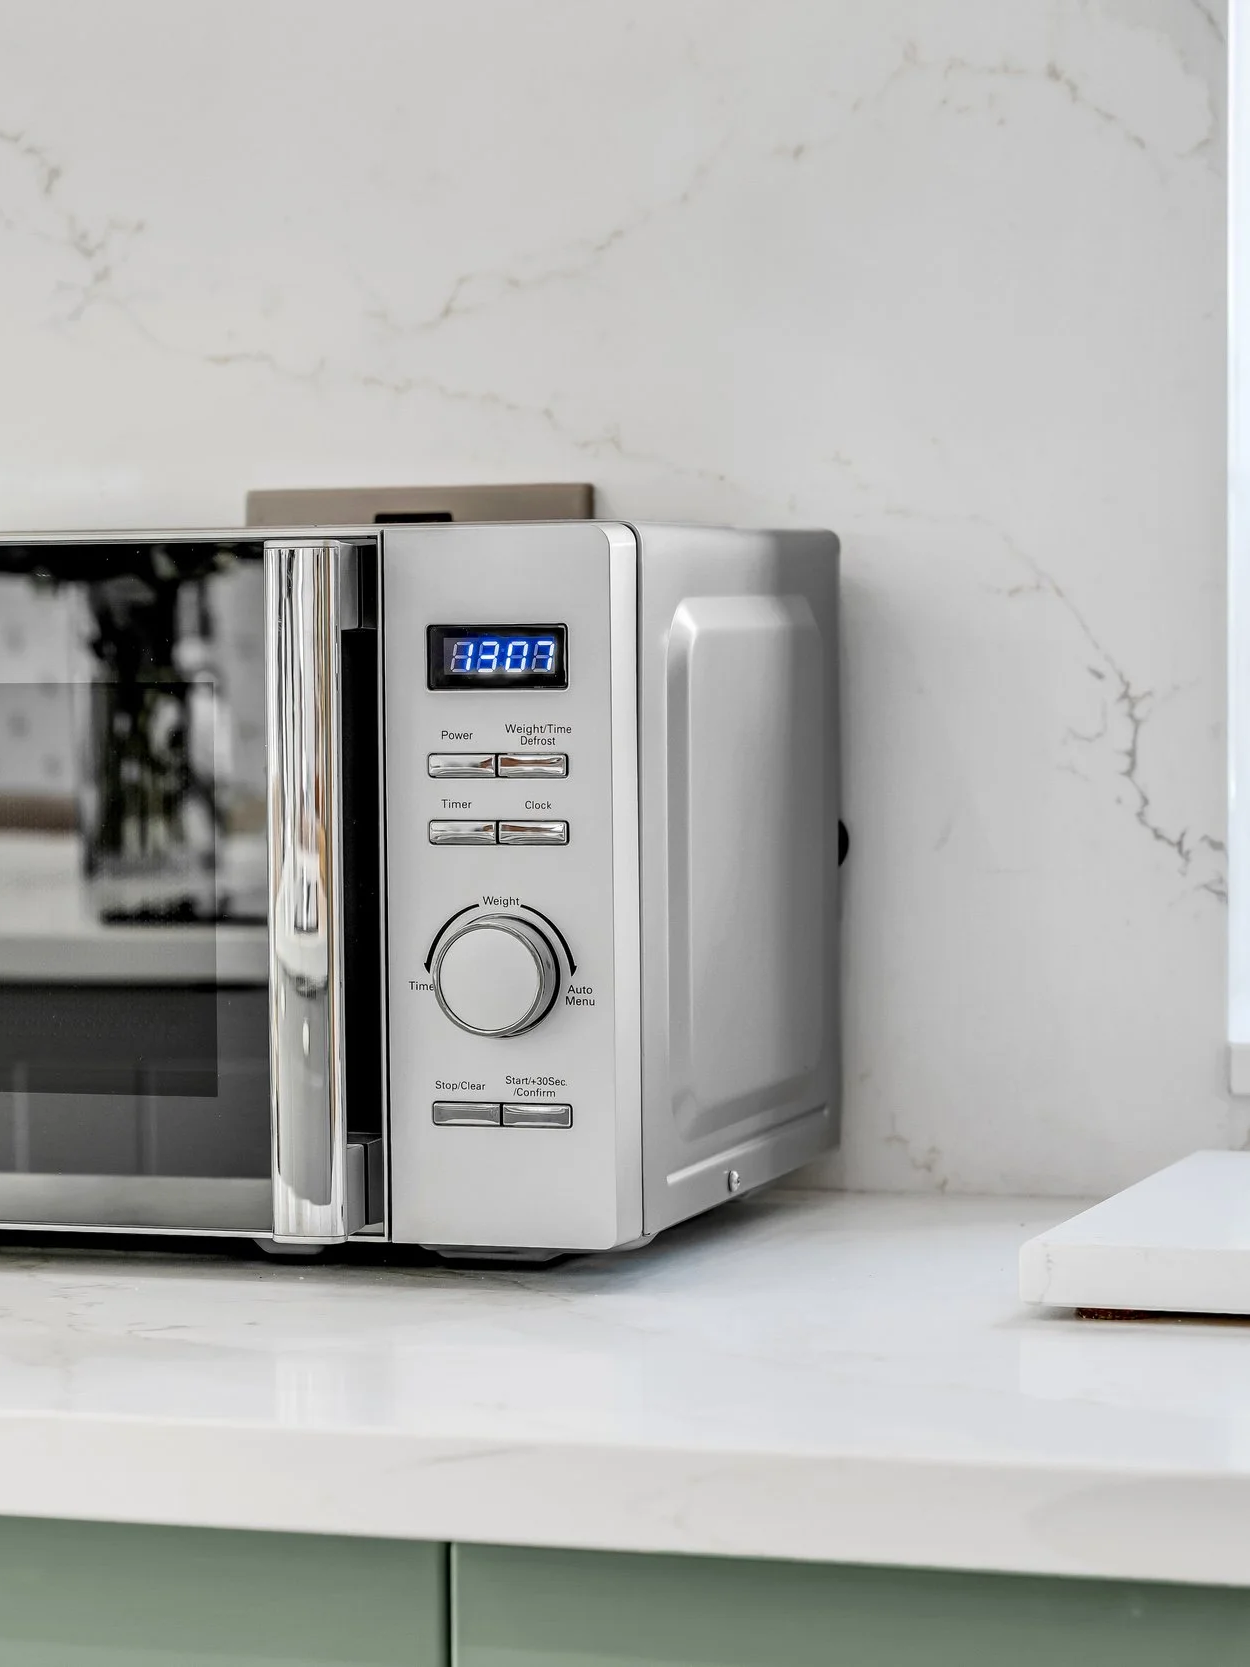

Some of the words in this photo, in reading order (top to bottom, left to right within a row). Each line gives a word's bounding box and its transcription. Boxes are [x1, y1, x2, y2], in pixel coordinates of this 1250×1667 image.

[505, 723, 572, 735] Weight/Time
[441, 730, 473, 740] Power
[520, 736, 556, 746] Defrost
[441, 799, 472, 809] Timer
[525, 800, 552, 810] Clock
[482, 896, 520, 908] Weight
[567, 984, 593, 995] Auto
[565, 996, 595, 1006] Menu
[435, 1080, 486, 1091] Stop/Clear
[505, 1075, 568, 1087] Start/+30Sec.
[513, 1087, 556, 1098] /Confirm
